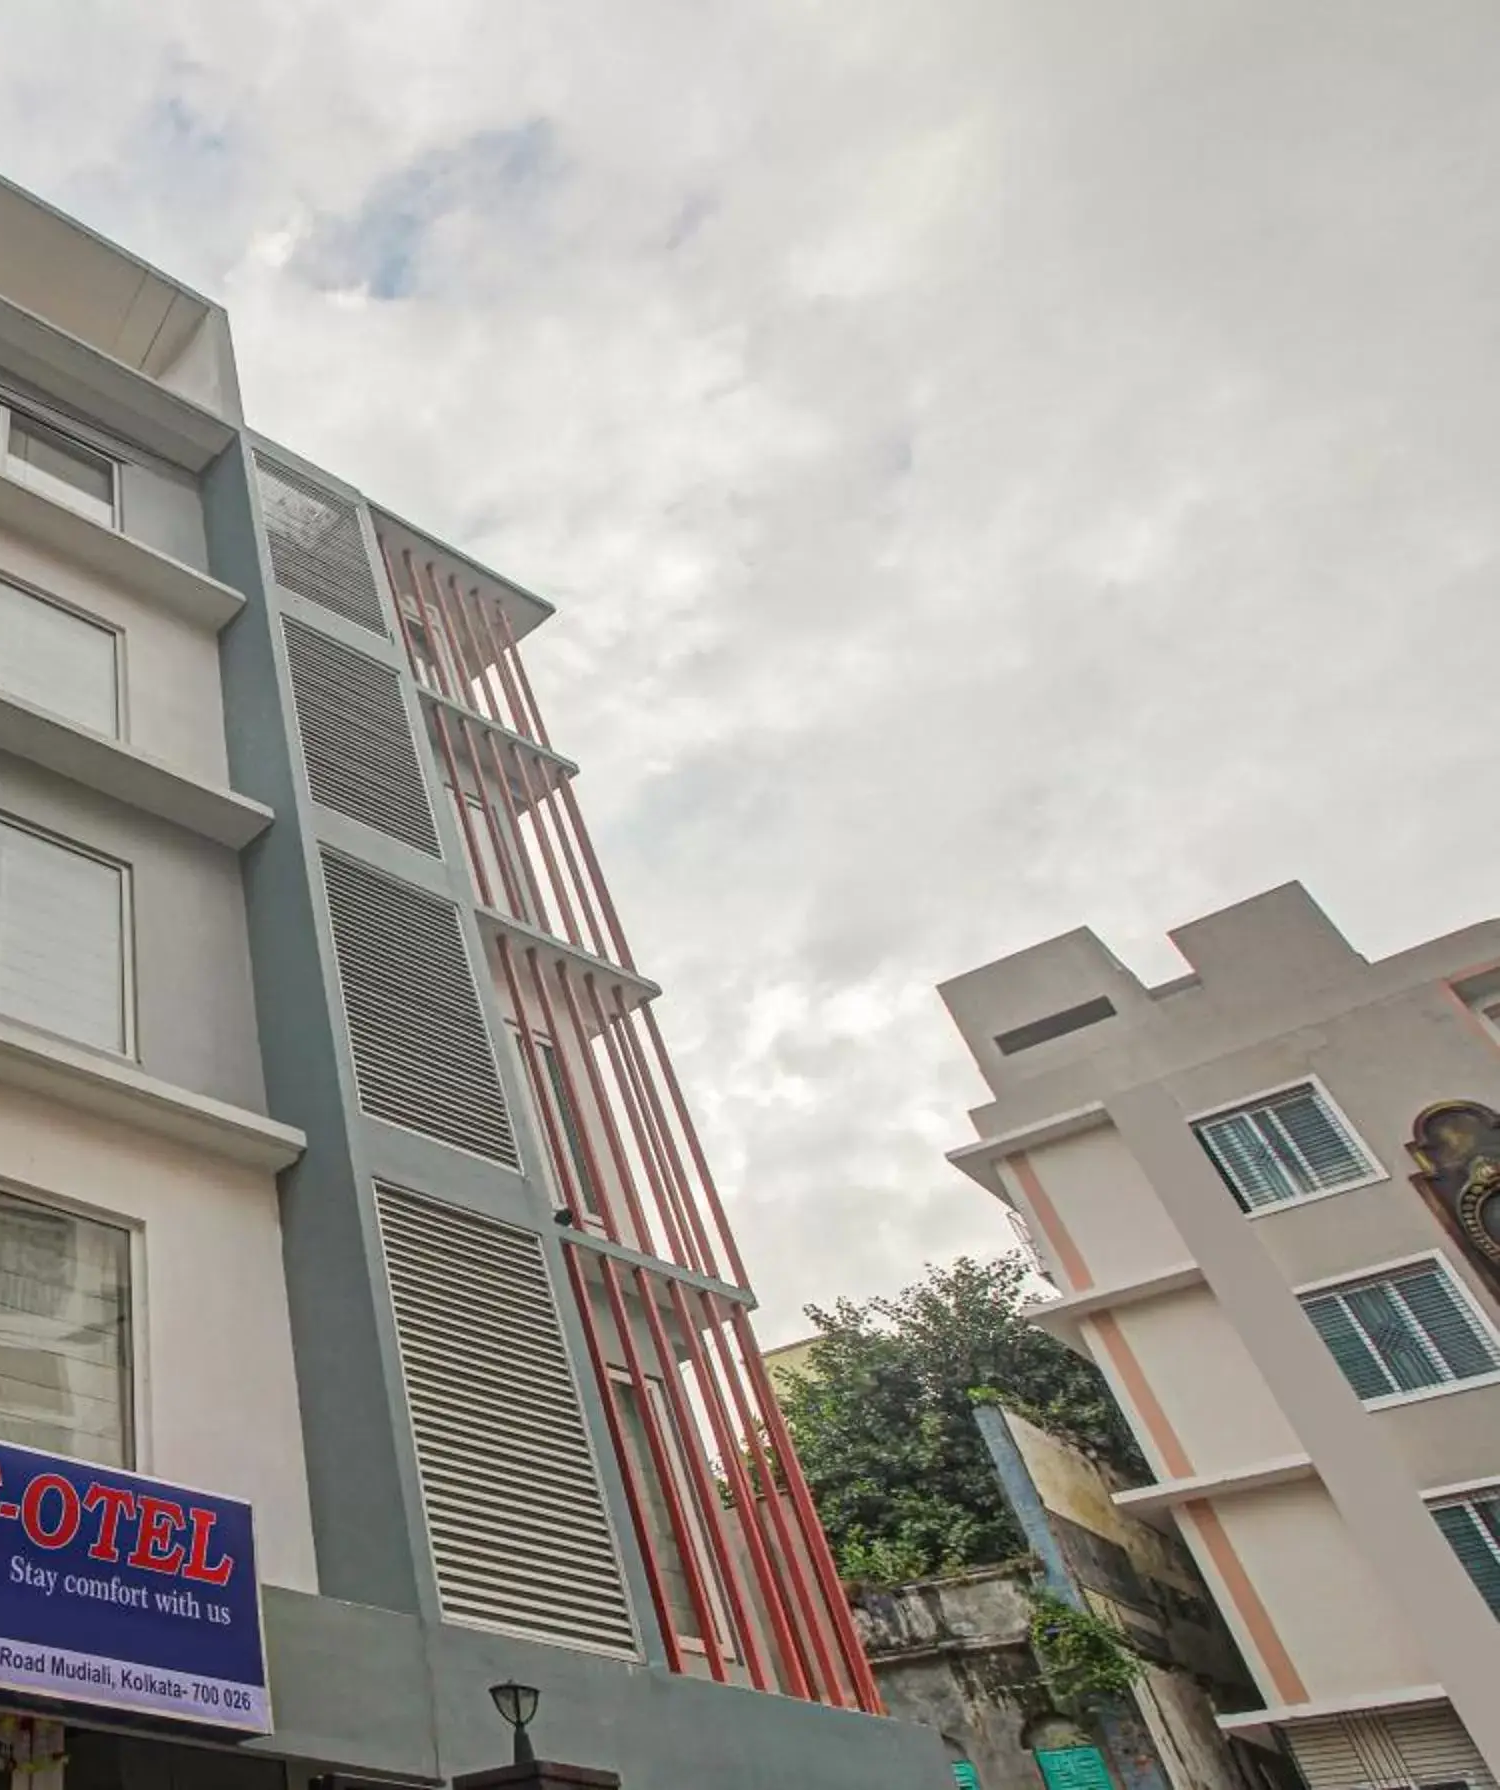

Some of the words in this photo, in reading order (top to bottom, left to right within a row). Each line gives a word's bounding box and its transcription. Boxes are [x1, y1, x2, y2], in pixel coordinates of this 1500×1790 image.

[10, 1555, 58, 1596] Stay
[64, 1577, 149, 1609] comfort
[154, 1590, 201, 1619] with
[206, 1605, 232, 1625] us
[0, 1647, 46, 1673] Road
[51, 1656, 118, 1689] Mudiali,
[120, 1669, 188, 1699] Kolkata-
[192, 1683, 220, 1707] 700
[223, 1689, 252, 1712] 026
